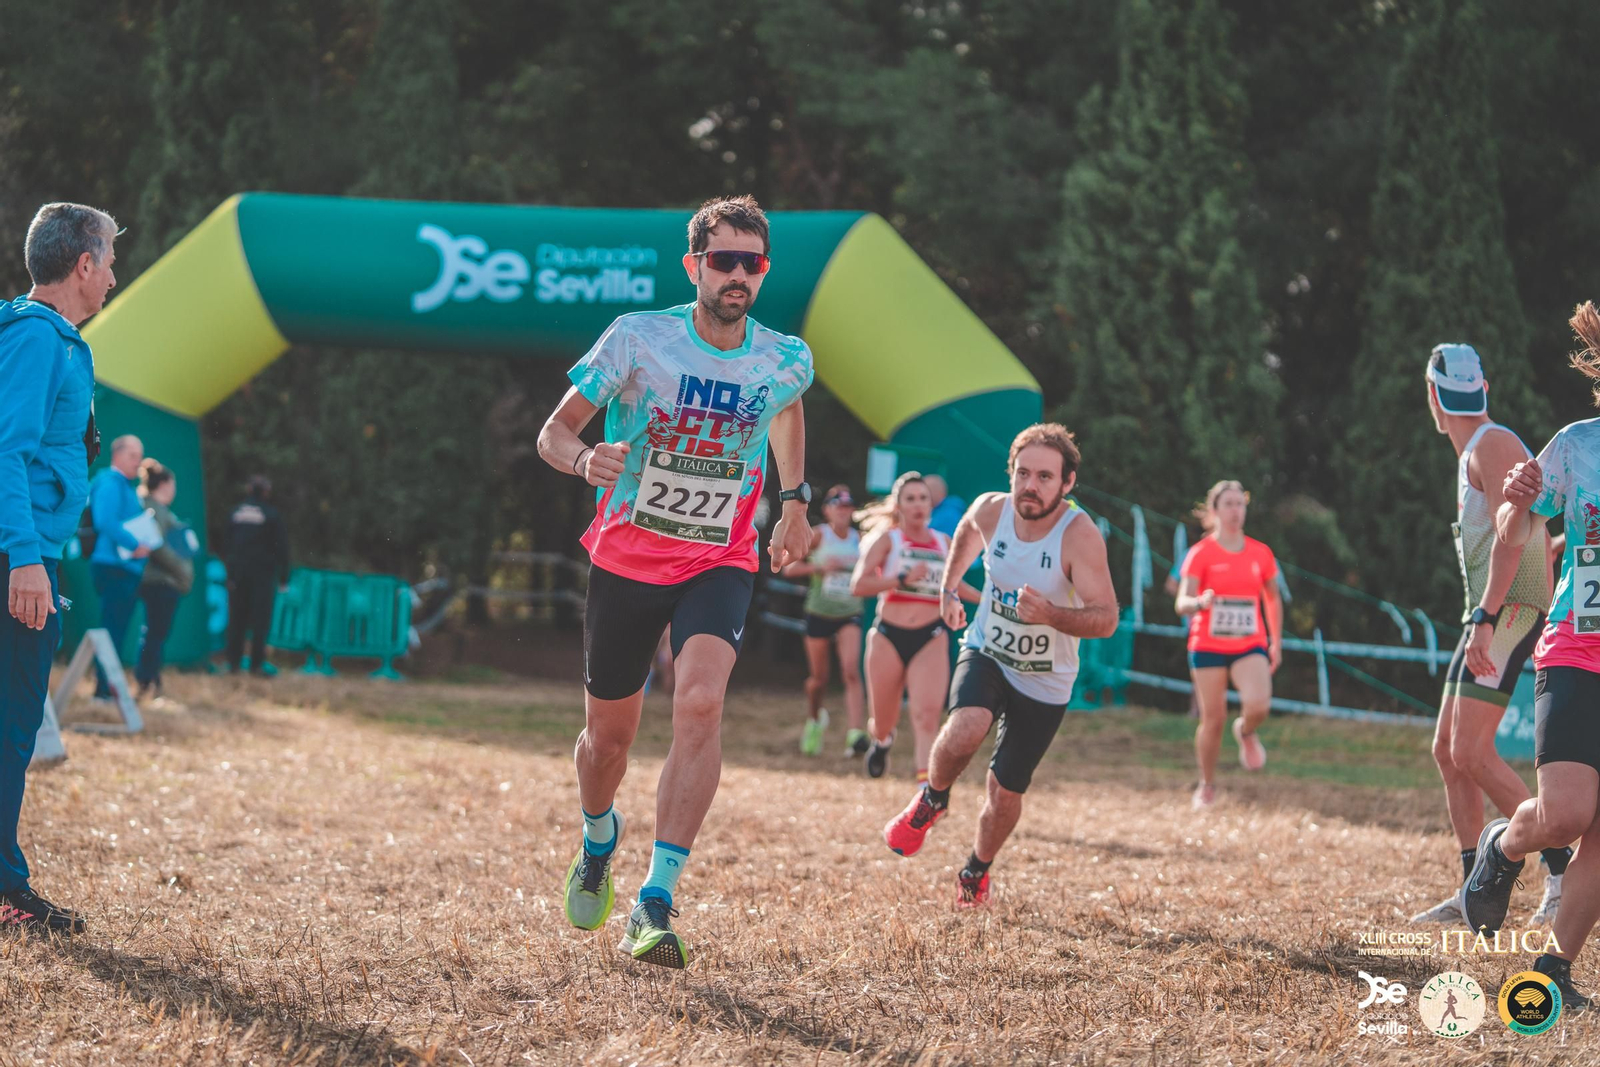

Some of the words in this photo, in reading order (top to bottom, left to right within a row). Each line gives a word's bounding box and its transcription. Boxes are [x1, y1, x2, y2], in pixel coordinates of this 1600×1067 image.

[534, 268, 656, 302] Sevilla
[684, 375, 741, 411] NO
[676, 407, 735, 438] CT
[677, 458, 721, 473] ITÁLICA
[646, 482, 732, 519] 2227
[991, 626, 1049, 655] 2209
